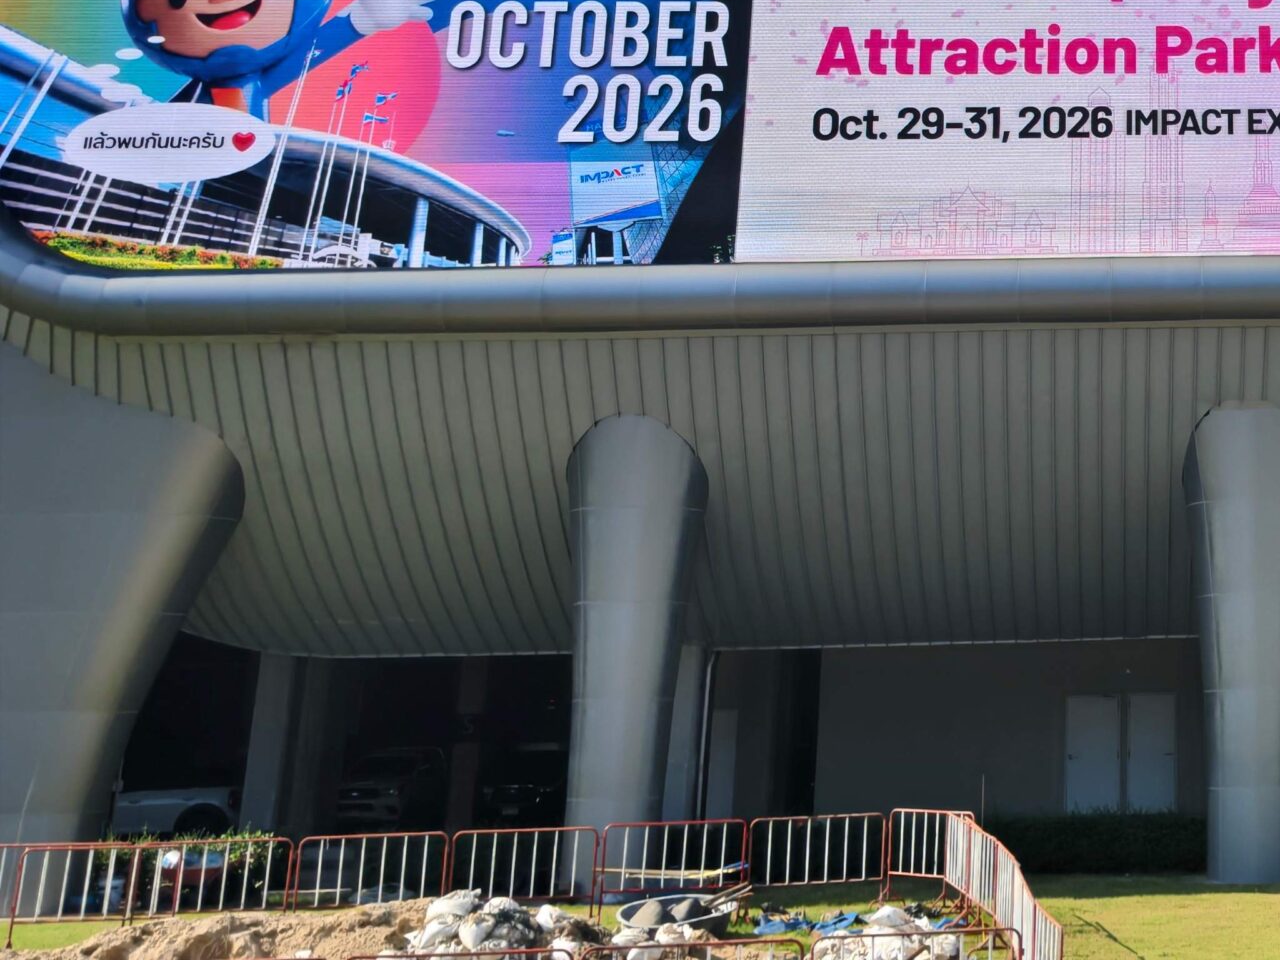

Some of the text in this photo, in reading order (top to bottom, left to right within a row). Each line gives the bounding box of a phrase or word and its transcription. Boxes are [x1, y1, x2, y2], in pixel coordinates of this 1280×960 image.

[446, 0, 731, 69] OCTOBER
[816, 23, 1138, 76] Attraction
[557, 72, 725, 144] 2026
[812, 106, 888, 141] Oct.
[1018, 105, 1114, 139] 2026
[1126, 109, 1242, 137] IMPACT
[83, 131, 226, 150] แล้วพบกันนะครับ
[580, 163, 644, 184] IMPACT
